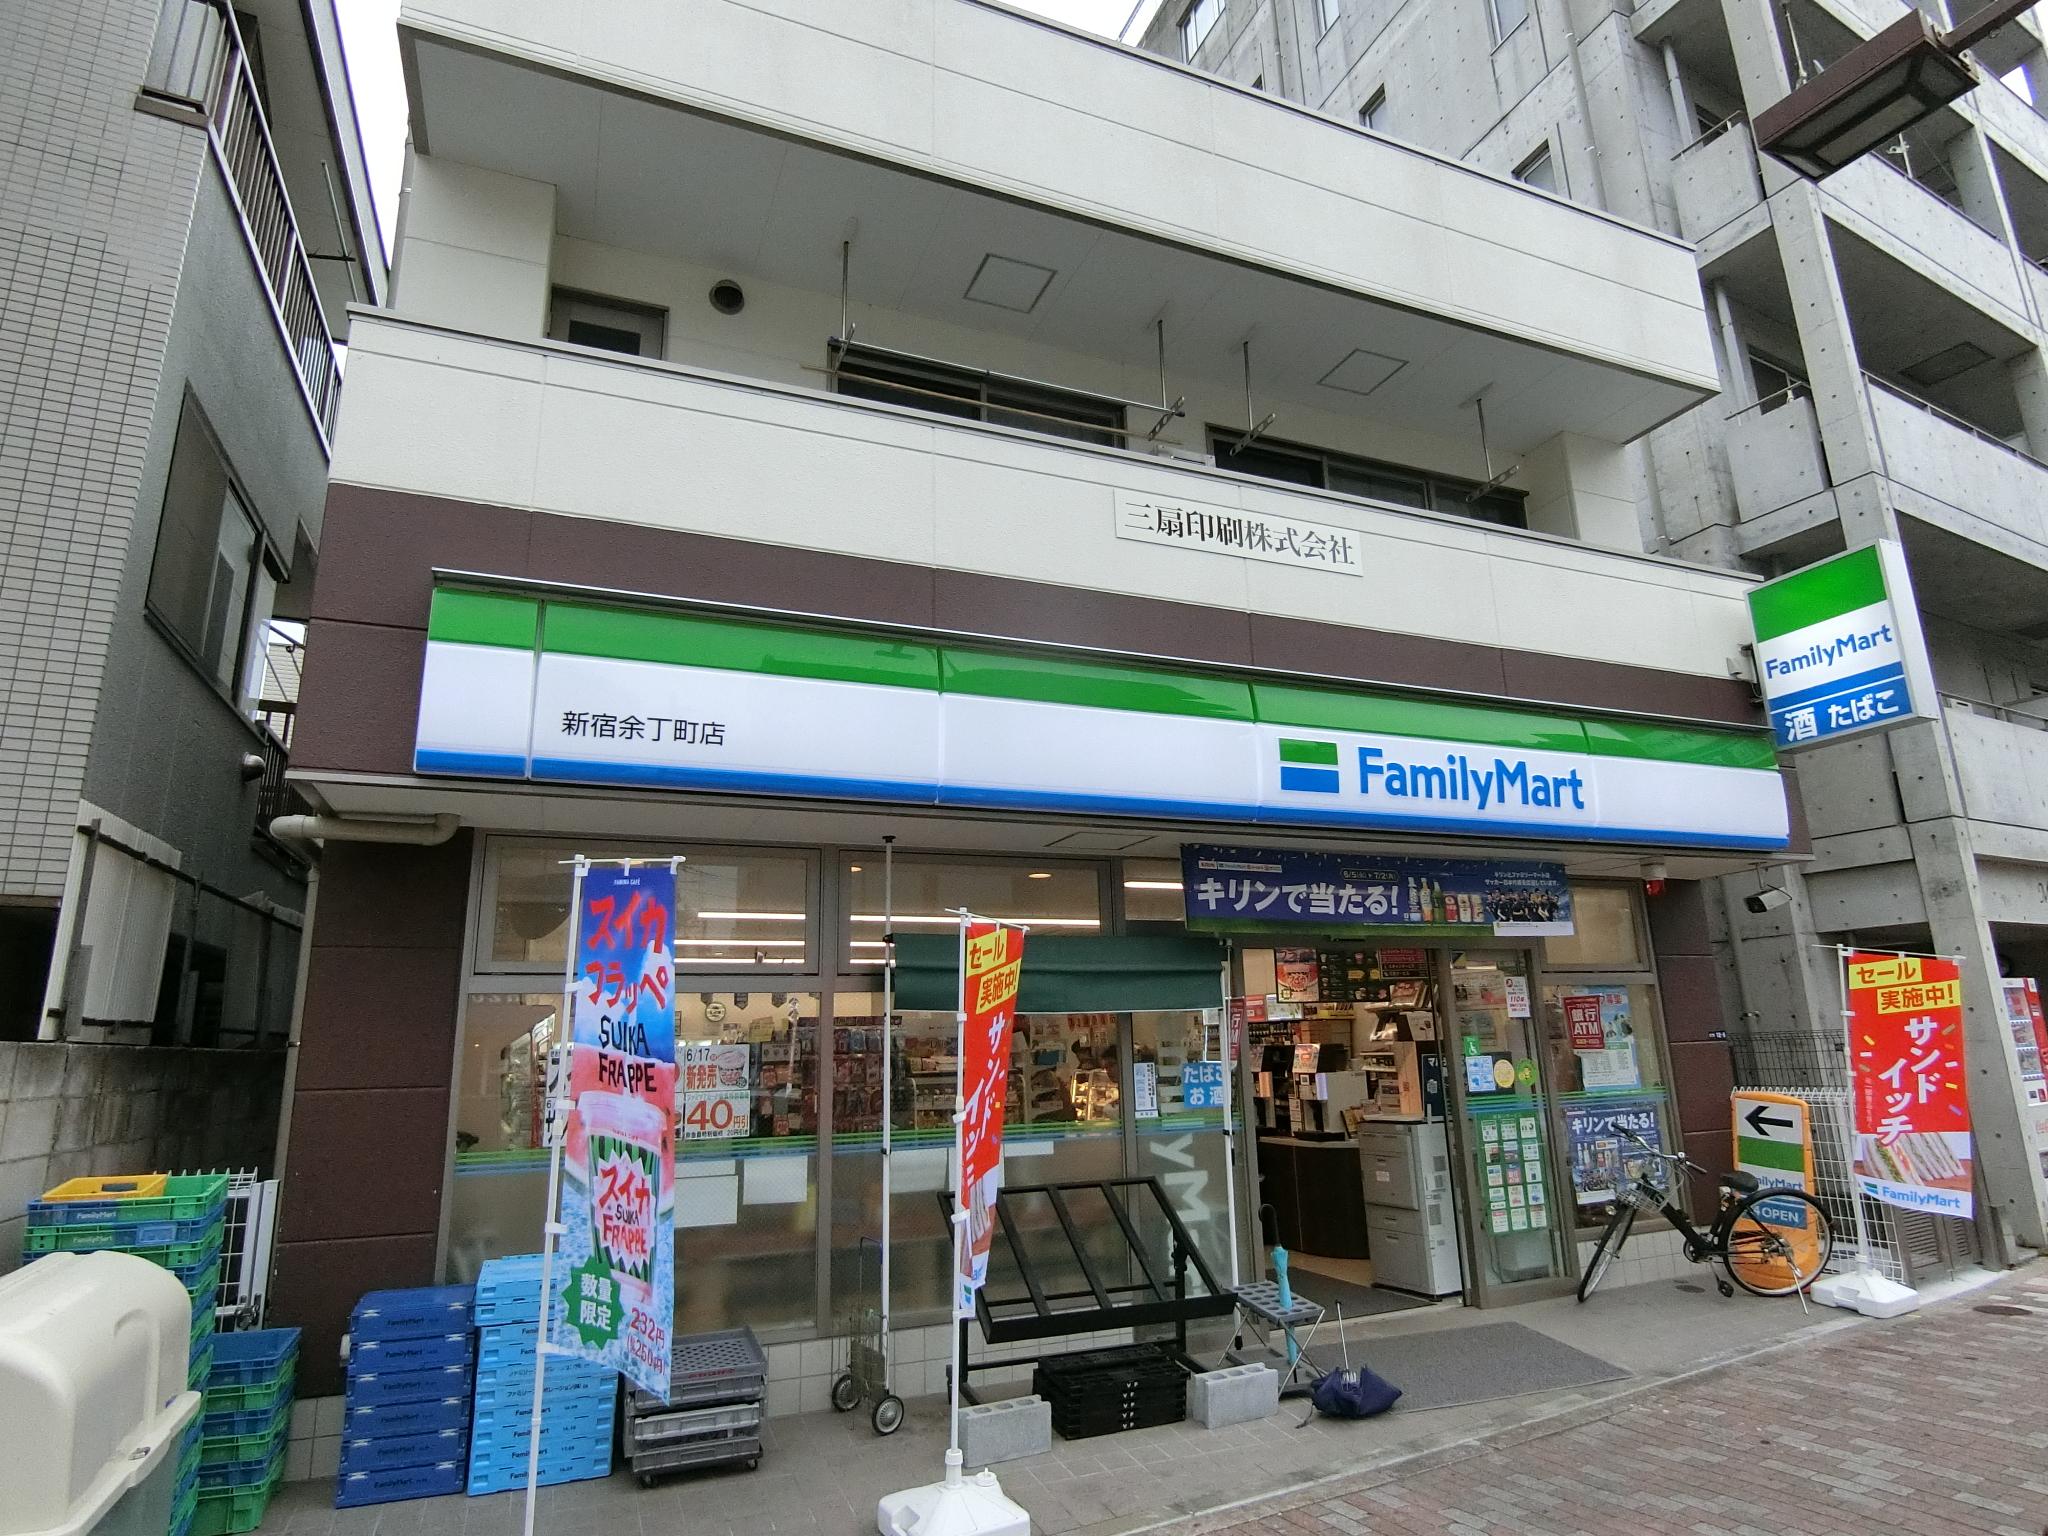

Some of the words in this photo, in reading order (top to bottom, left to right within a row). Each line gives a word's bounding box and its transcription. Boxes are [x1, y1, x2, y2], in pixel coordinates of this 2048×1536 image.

[1124, 502, 1356, 566] 三扇印刷株式会社
[1764, 624, 1893, 680] FamilyMart
[561, 710, 726, 746] 新宿余丁町店
[1784, 706, 1818, 742] 酒
[1827, 689, 1899, 729] たばこ
[1357, 746, 1585, 810] FamilyMart
[1197, 877, 1399, 916] キリンで当たる!
[587, 890, 669, 954] スイカ
[969, 934, 1005, 969] セール
[585, 960, 670, 1015] フラッペ
[1856, 961, 1917, 985] セール
[1571, 1008, 1597, 1022] 銀行
[1879, 983, 1954, 1011] 実施中!
[598, 1015, 651, 1056] SUIKA
[1574, 1022, 1599, 1035] ATM
[597, 1052, 658, 1093] FRAPPE
[686, 1048, 710, 1063] 6/17
[1904, 1015, 1941, 1105] サンド
[1876, 1058, 1914, 1146] イッチ
[599, 1164, 651, 1226] スイカ
[1761, 1207, 1799, 1223] OPEN
[1881, 1185, 1961, 1210] FamilyMart
[602, 1215, 648, 1255] FRAPPE
[580, 1272, 613, 1304] 数量
[579, 1301, 613, 1332] 限定
[630, 1306, 665, 1349] 232円
